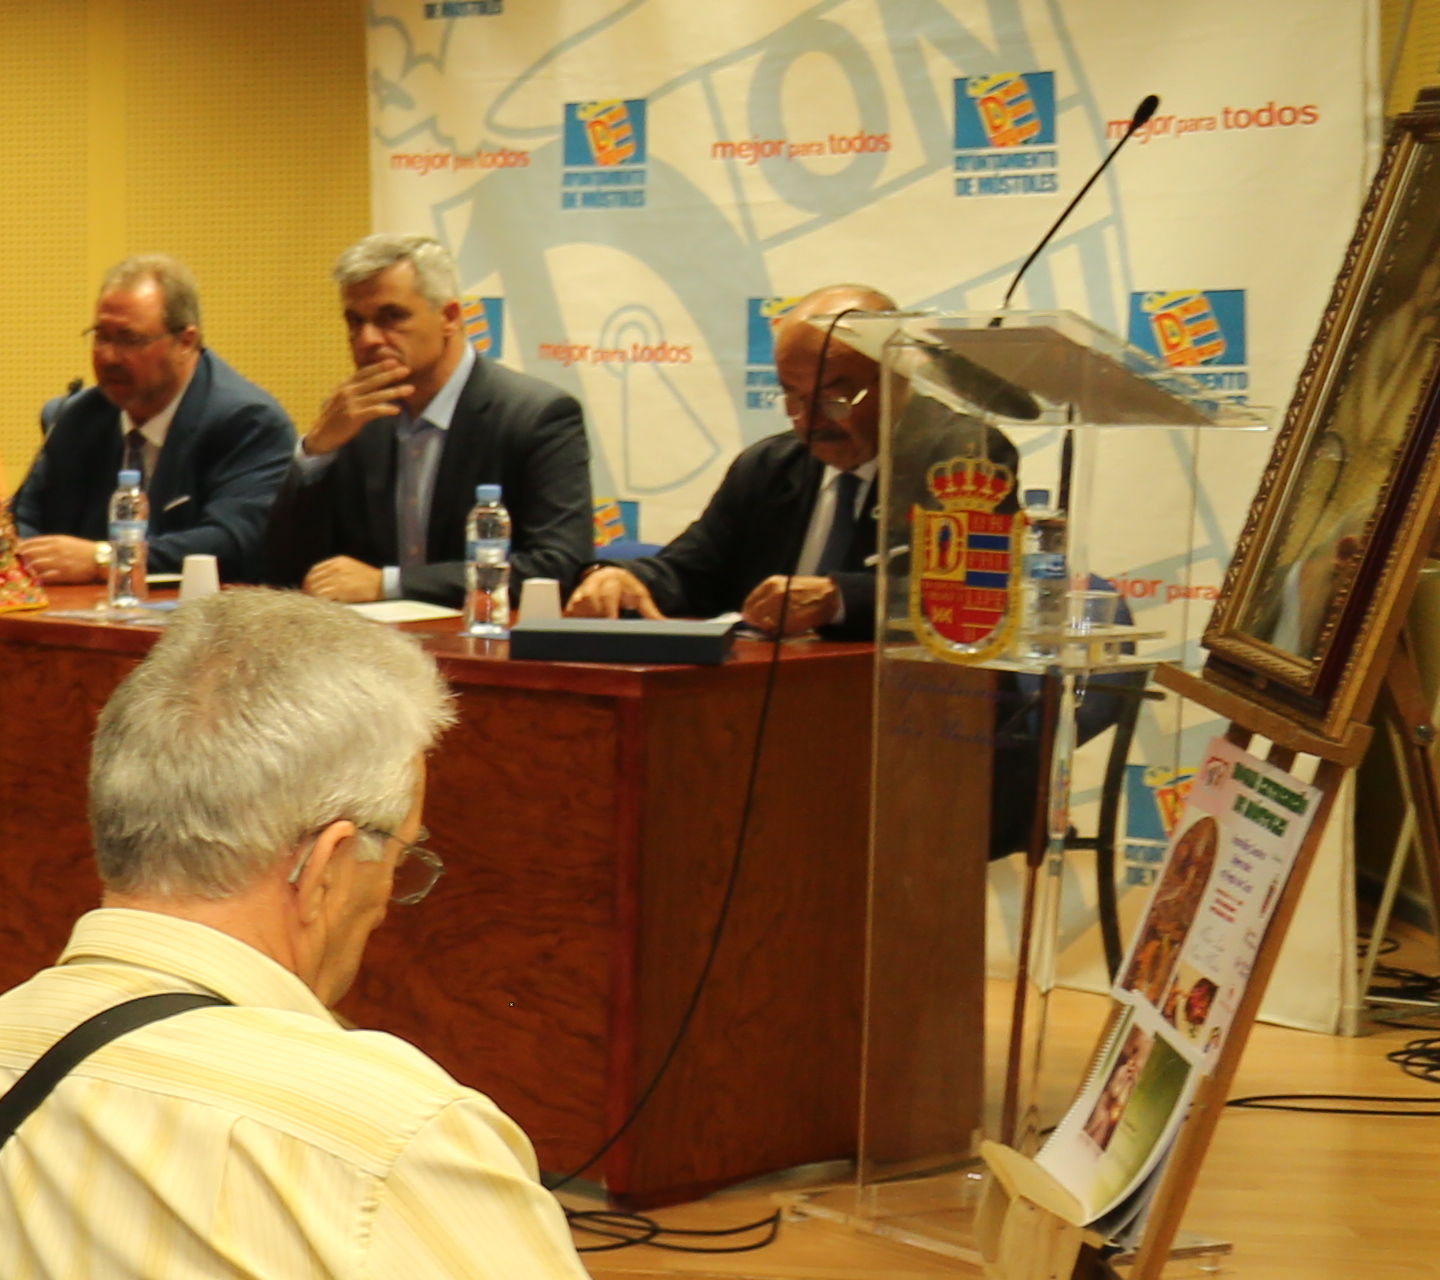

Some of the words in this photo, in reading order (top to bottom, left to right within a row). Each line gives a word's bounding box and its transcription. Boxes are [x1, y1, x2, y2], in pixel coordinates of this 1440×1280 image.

[1176, 116, 1218, 135] para
[1221, 101, 1319, 130] todos
[391, 151, 451, 176] mejor
[476, 149, 530, 169] todos
[712, 137, 785, 165] mejor
[789, 140, 825, 160] para
[829, 130, 892, 155] todos
[538, 342, 591, 367] mejor
[593, 345, 626, 365] para
[631, 342, 692, 364] todos
